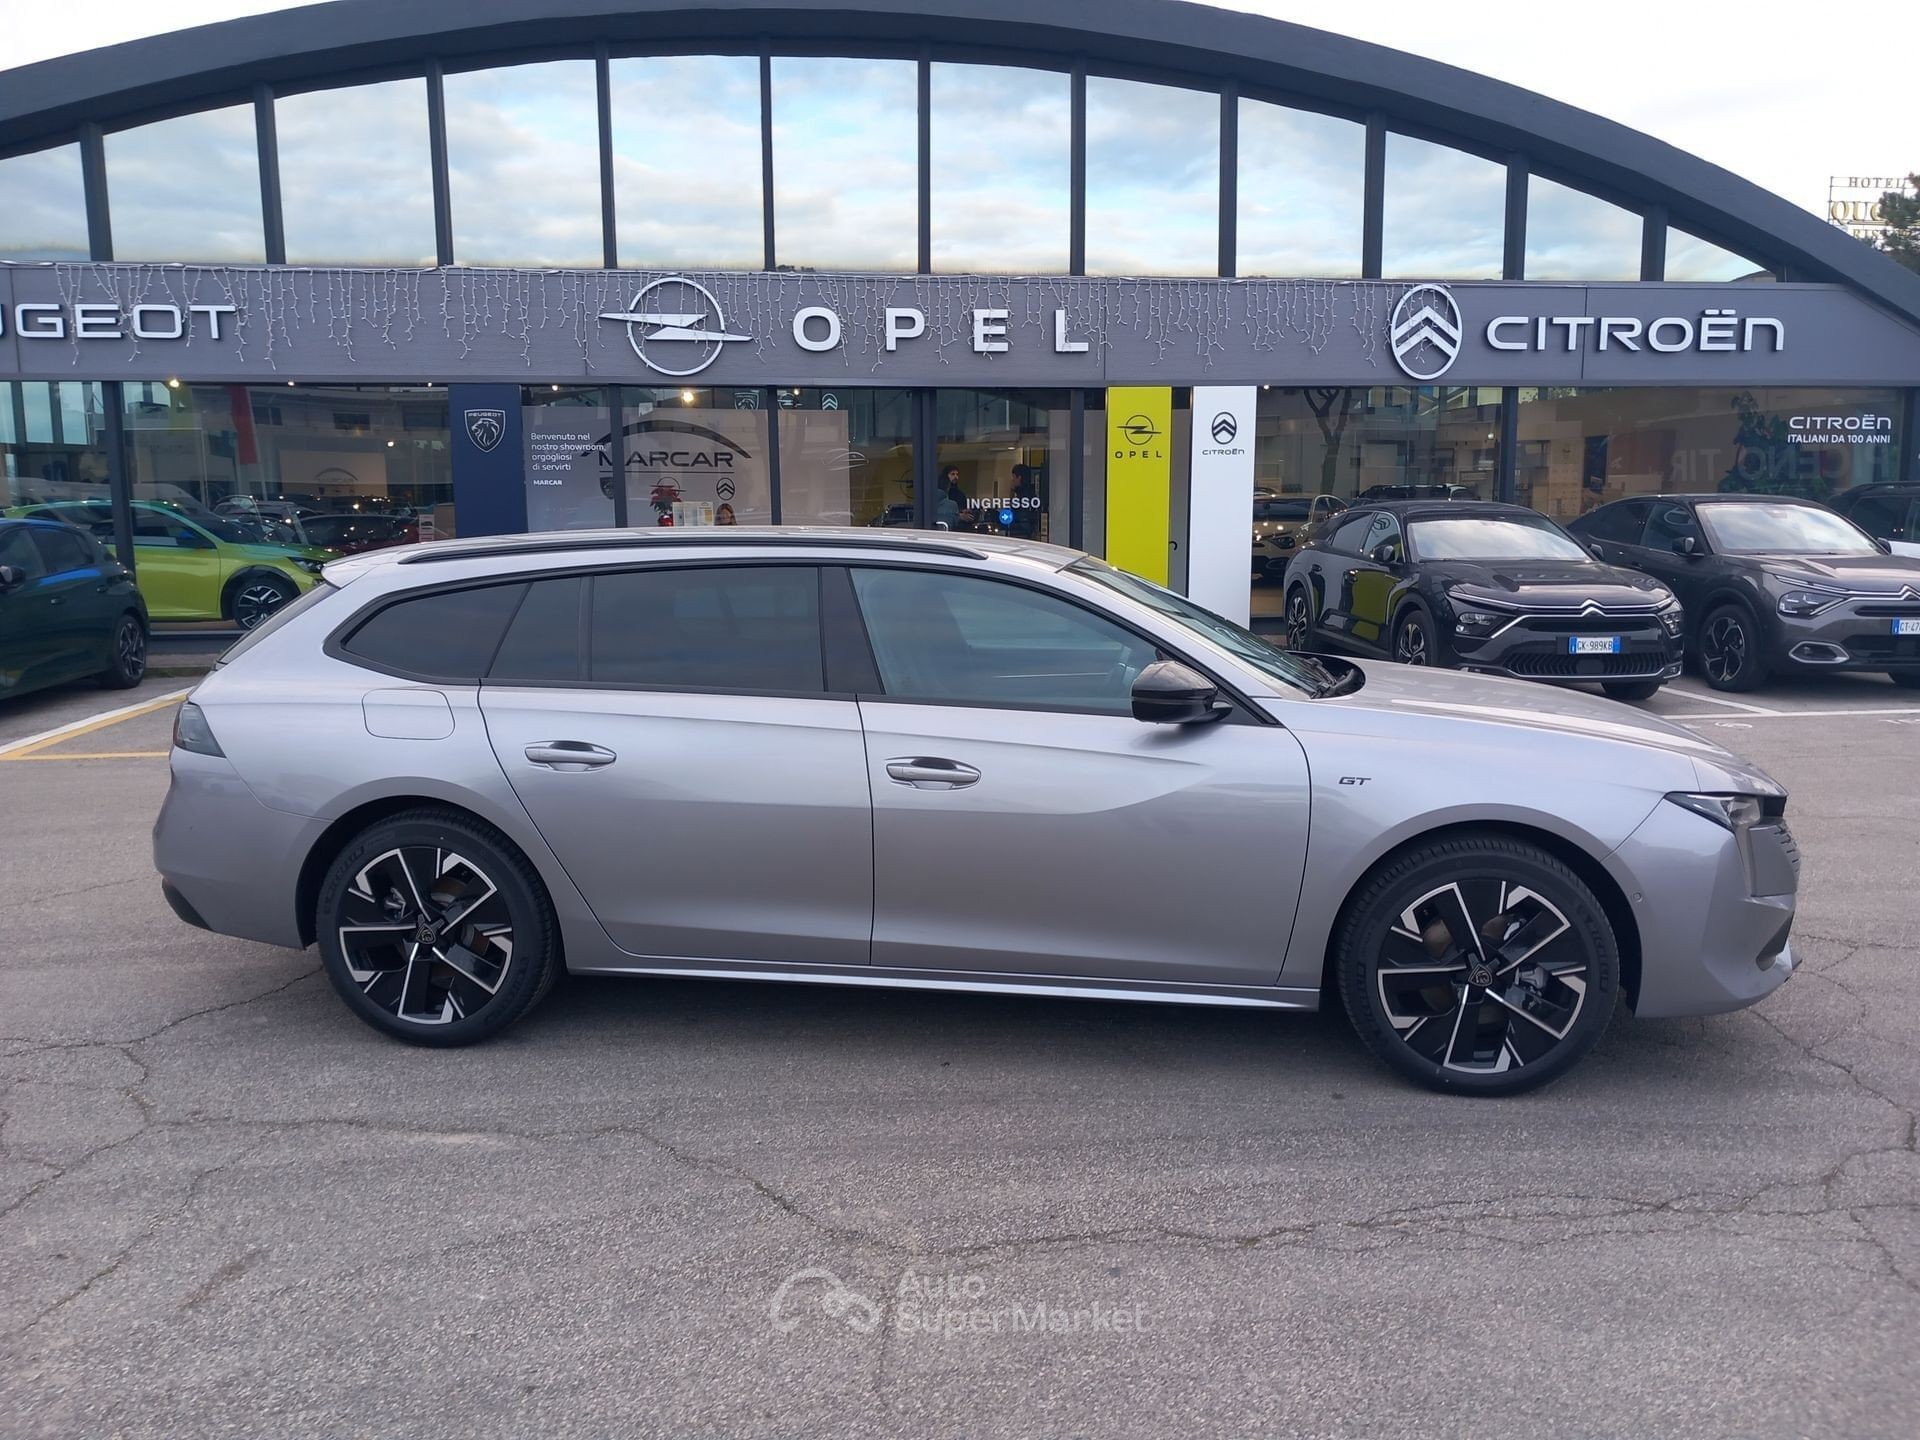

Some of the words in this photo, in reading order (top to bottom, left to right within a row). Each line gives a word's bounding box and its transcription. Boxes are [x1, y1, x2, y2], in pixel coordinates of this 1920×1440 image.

[1848, 176, 1904, 188] HOTEL
[0, 303, 236, 340] GEOT
[792, 306, 1090, 352] OPEL
[530, 432, 576, 441] Benvenuto
[577, 432, 590, 441] nel
[1787, 434, 1829, 443] ITALIANI
[1831, 434, 1846, 443] DA
[1847, 434, 1864, 443] 100
[1865, 434, 1891, 443] ANNI
[531, 443, 559, 451] nostro
[531, 453, 573, 463] orgogliosi
[1114, 450, 1163, 459] OPEL
[532, 463, 541, 471] di
[541, 463, 572, 471] servirti
[966, 497, 1041, 510] INGRESSO
[1338, 776, 1372, 786] GT
